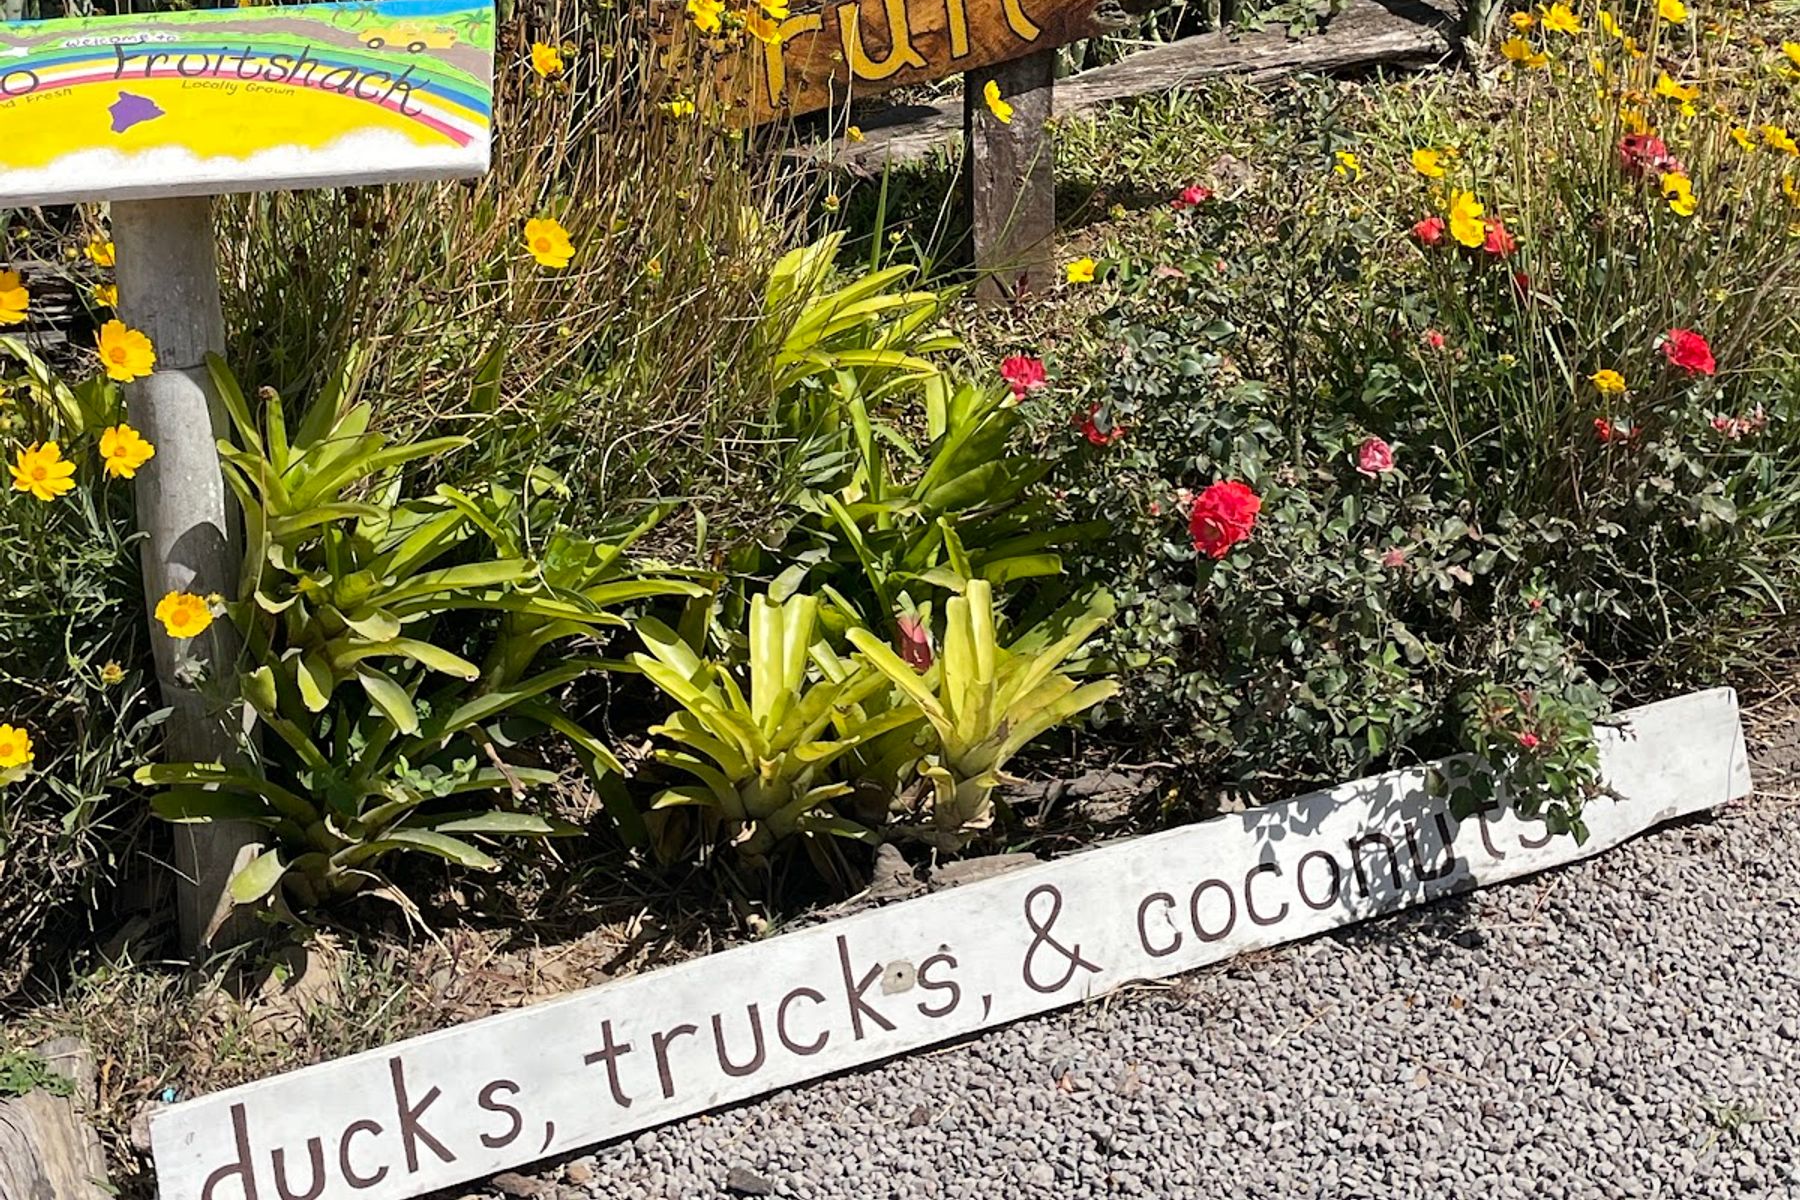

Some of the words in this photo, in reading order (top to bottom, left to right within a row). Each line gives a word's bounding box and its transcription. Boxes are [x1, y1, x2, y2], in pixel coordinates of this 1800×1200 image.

[181, 79, 239, 96] Locally
[583, 934, 993, 1109] trucks,
[1022, 883, 1104, 994] &
